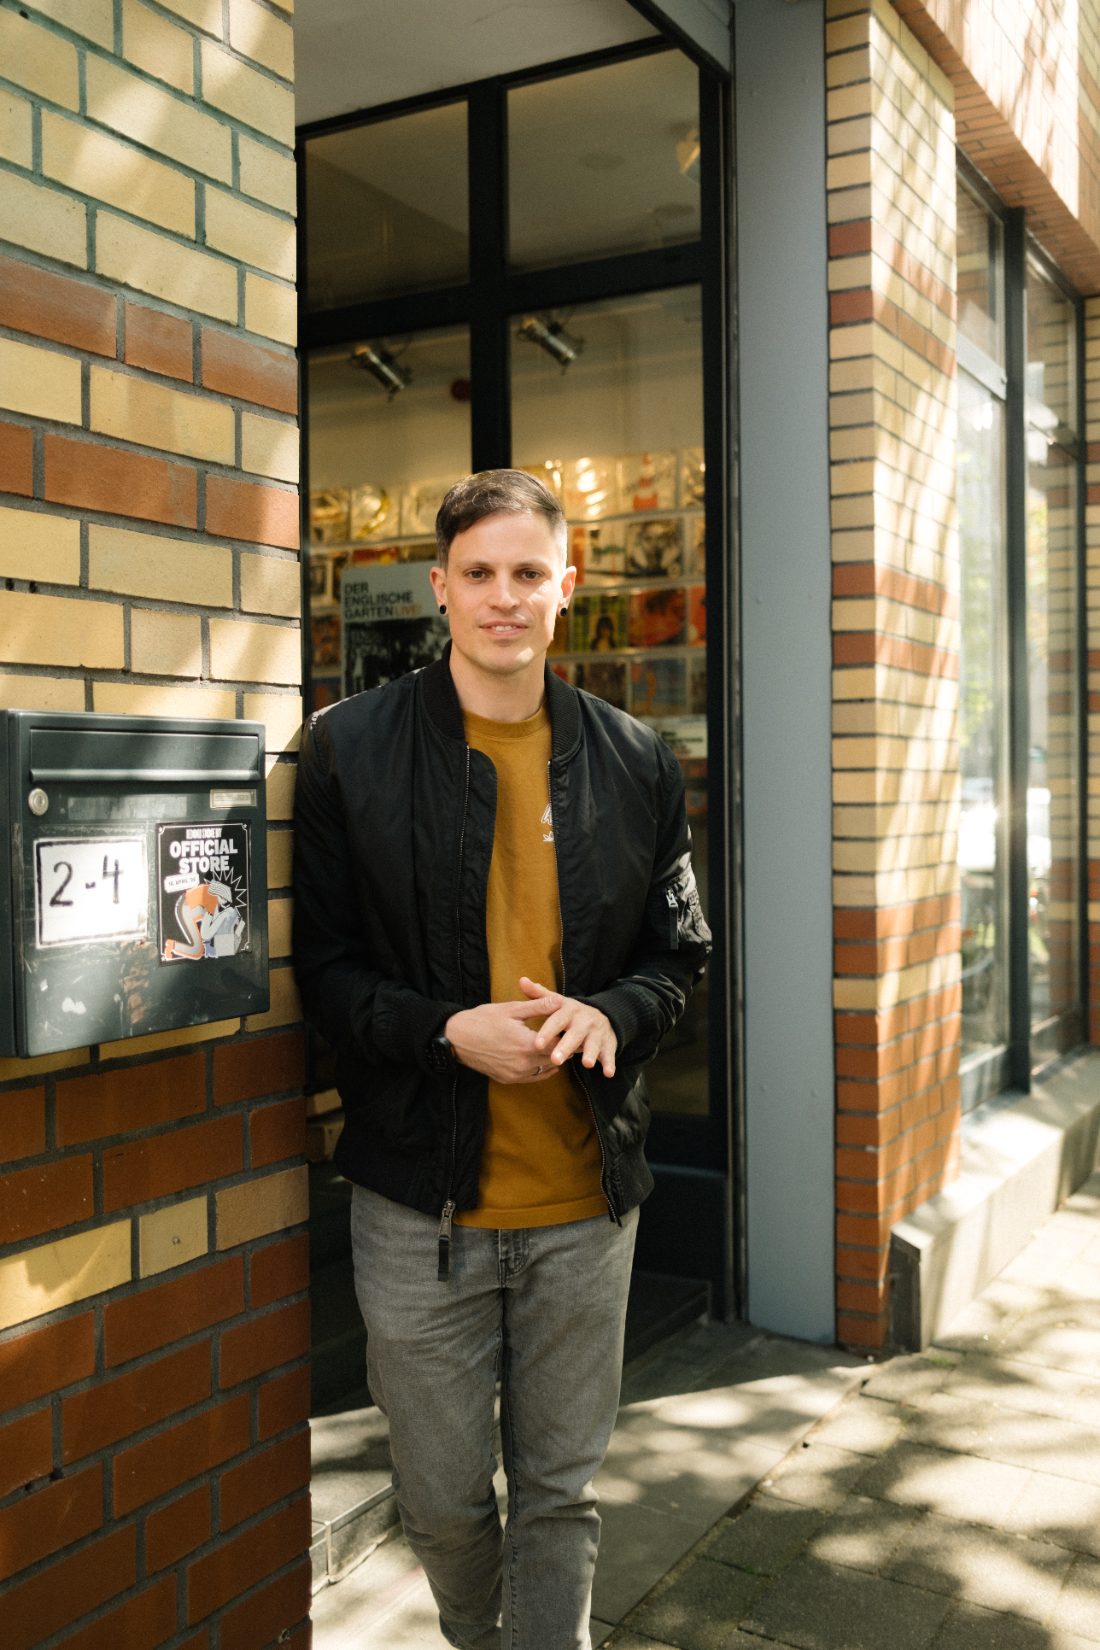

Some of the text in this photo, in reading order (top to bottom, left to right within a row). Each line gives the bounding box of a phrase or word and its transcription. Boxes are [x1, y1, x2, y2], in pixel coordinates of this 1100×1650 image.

[344, 582, 369, 595] DER
[344, 591, 413, 608] ENGLISCHE
[344, 605, 394, 619] GARTEN
[169, 838, 239, 859] OFFICIAL
[178, 855, 230, 874] STORE
